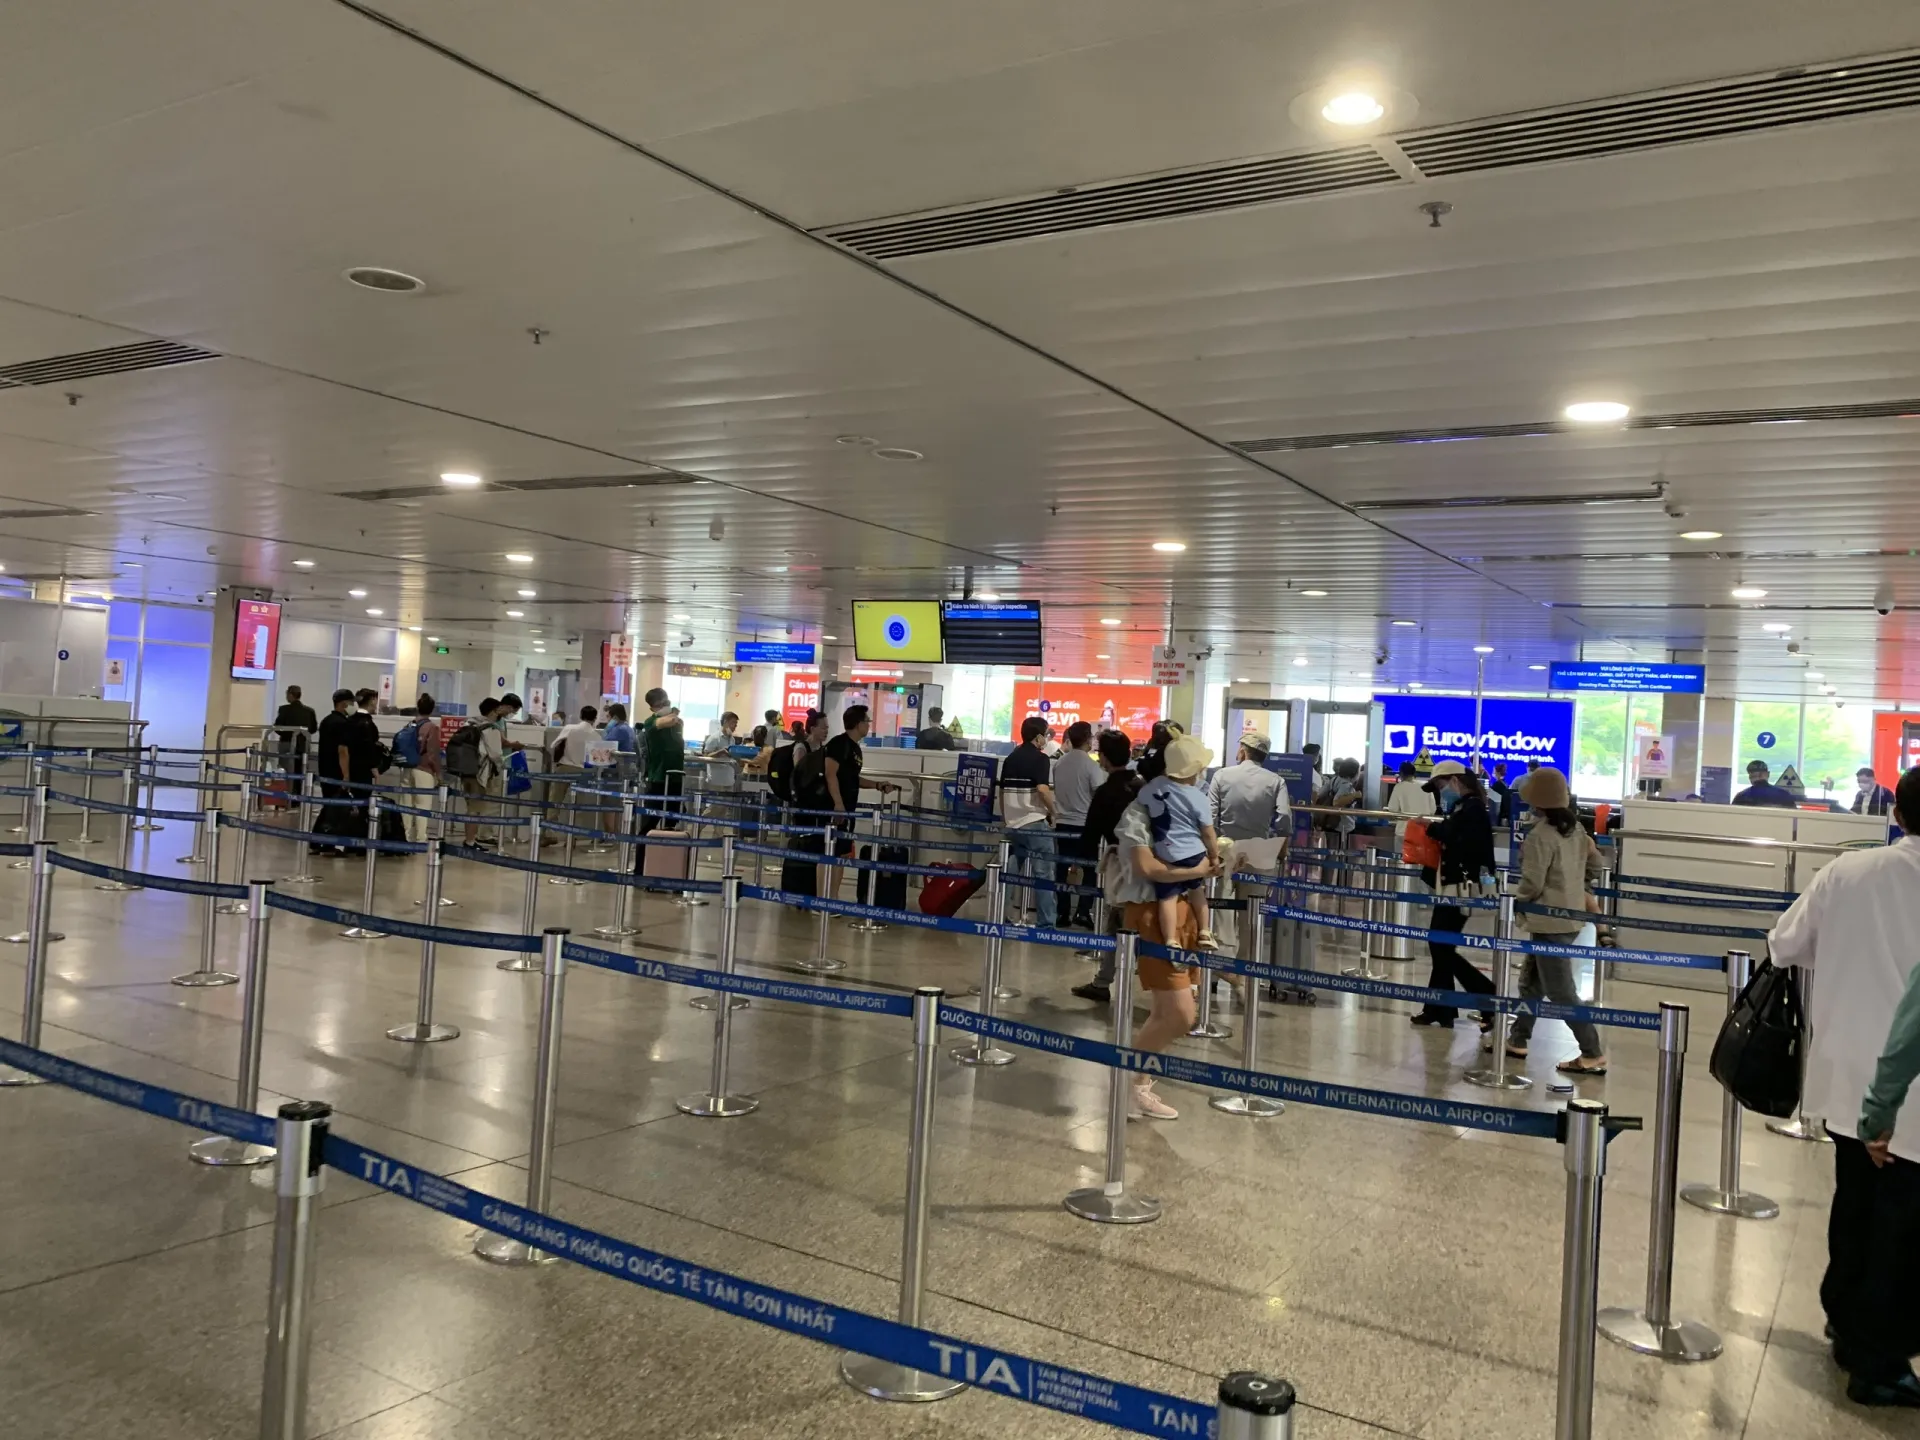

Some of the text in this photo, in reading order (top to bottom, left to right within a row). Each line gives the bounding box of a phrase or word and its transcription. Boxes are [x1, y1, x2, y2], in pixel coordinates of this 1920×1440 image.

[61, 651, 66, 659] 2
[909, 696, 915, 704] 5
[1043, 703, 1048, 711] 6
[1422, 725, 1556, 751] Eurowindow
[1763, 734, 1770, 745] 7
[1238, 873, 1257, 883] TIA
[760, 890, 781, 901] TIA
[1428, 895, 1451, 904] TIA
[1546, 907, 1571, 918] TIA
[974, 923, 1000, 936] TIA
[1036, 932, 1050, 940] TAN
[1051, 934, 1067, 942] SON
[1068, 936, 1088, 945] NHAT
[1166, 948, 1201, 964] TIA
[1463, 935, 1492, 948] TIA
[1531, 944, 1546, 952] TAN
[1547, 946, 1565, 954] SON
[1566, 947, 1587, 956] NHAT
[1588, 949, 1653, 962] INTERNATIONAL
[1654, 955, 1691, 965] AIRPORT
[634, 960, 665, 978] TIA
[702, 974, 720, 987] TAN
[721, 976, 741, 989] SON
[742, 980, 766, 993] NHAT
[768, 984, 843, 1003] INTERNATIONAL
[843, 994, 888, 1010] AIRPORT
[1489, 998, 1533, 1015] TIA
[1589, 1011, 1610, 1021] TAN
[1612, 1014, 1637, 1024] SON
[1639, 1016, 1662, 1027] NHA
[1115, 1048, 1163, 1073] TIA
[1221, 1071, 1515, 1128] TAN SON NHAT INTERNATIONAL AIRPORT
[359, 1152, 413, 1194] TIA
[481, 1201, 522, 1232] CẢNG
[523, 1219, 567, 1249] HÀNG
[569, 1238, 625, 1270] KHÔNG
[627, 1255, 677, 1285] QUỐC
[679, 1269, 701, 1293] TẾ
[704, 1277, 740, 1306] TÂN
[742, 1292, 781, 1318] SƠN
[786, 1303, 836, 1334] NHẤT
[928, 1340, 1022, 1395] TIA
[1036, 1379, 1122, 1413] INTERNATIONAL
[1037, 1391, 1085, 1413] AIRPORT
[1148, 1404, 1198, 1436] TAN
